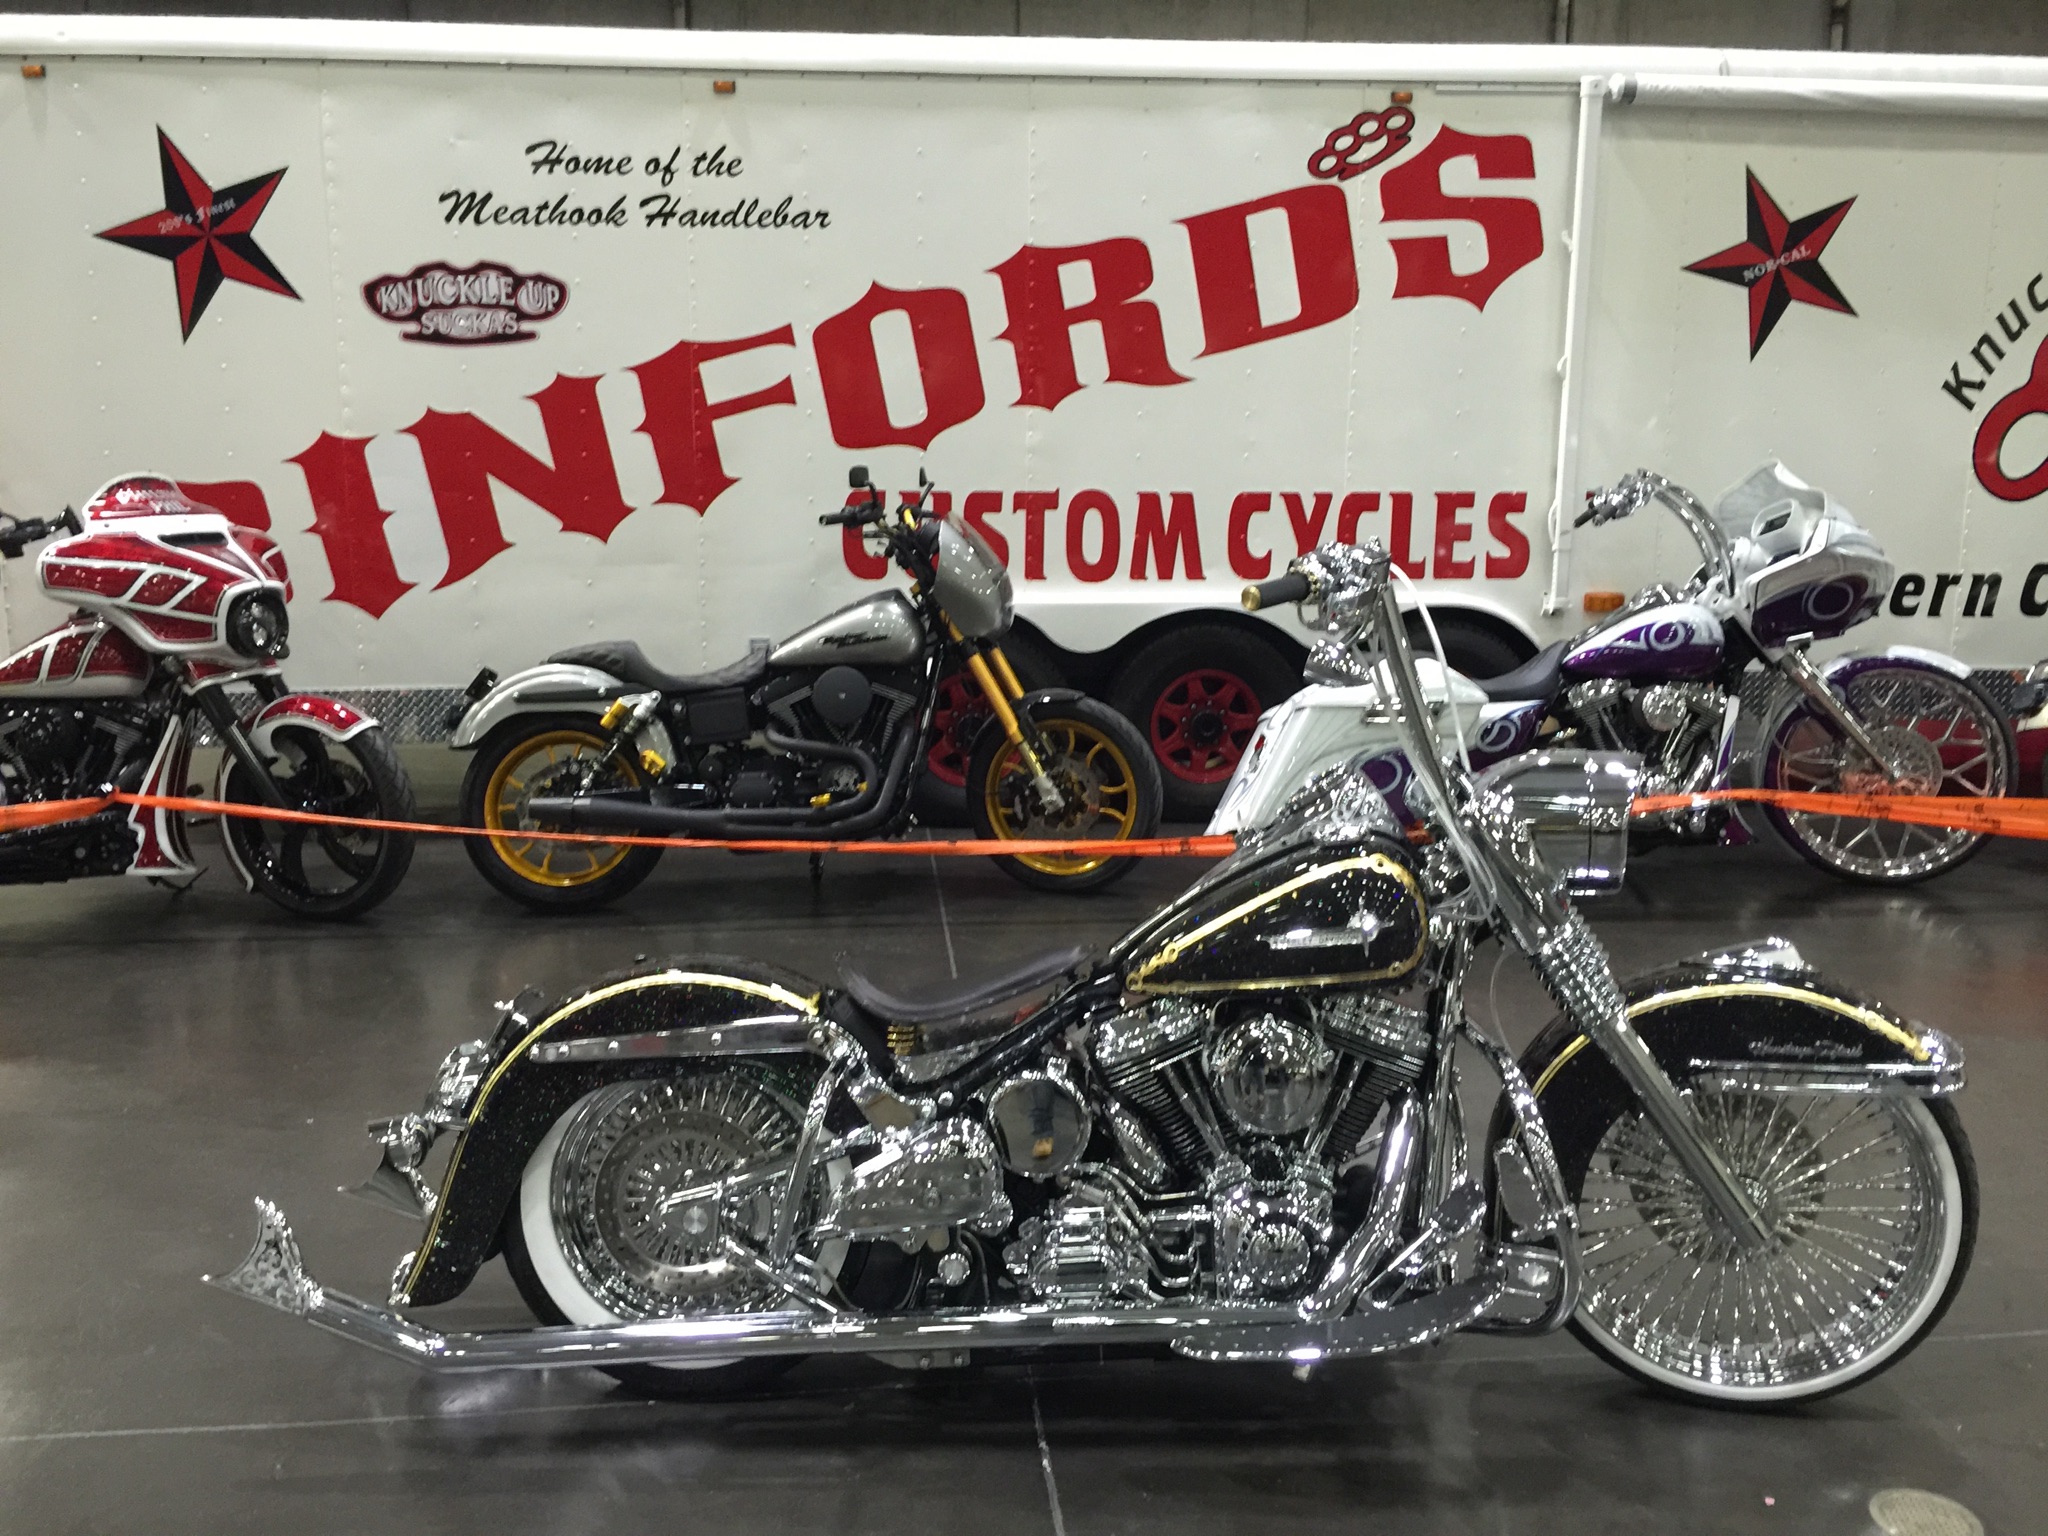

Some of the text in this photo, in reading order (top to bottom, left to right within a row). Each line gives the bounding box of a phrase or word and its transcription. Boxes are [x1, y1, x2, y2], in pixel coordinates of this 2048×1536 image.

[526, 140, 743, 187] Home of the
[439, 190, 831, 229] Meathook Handlebar
[379, 273, 560, 314] KNUCKLE UP
[420, 310, 518, 335] SUCKAS
[1228, 491, 1531, 580] CYCLES
